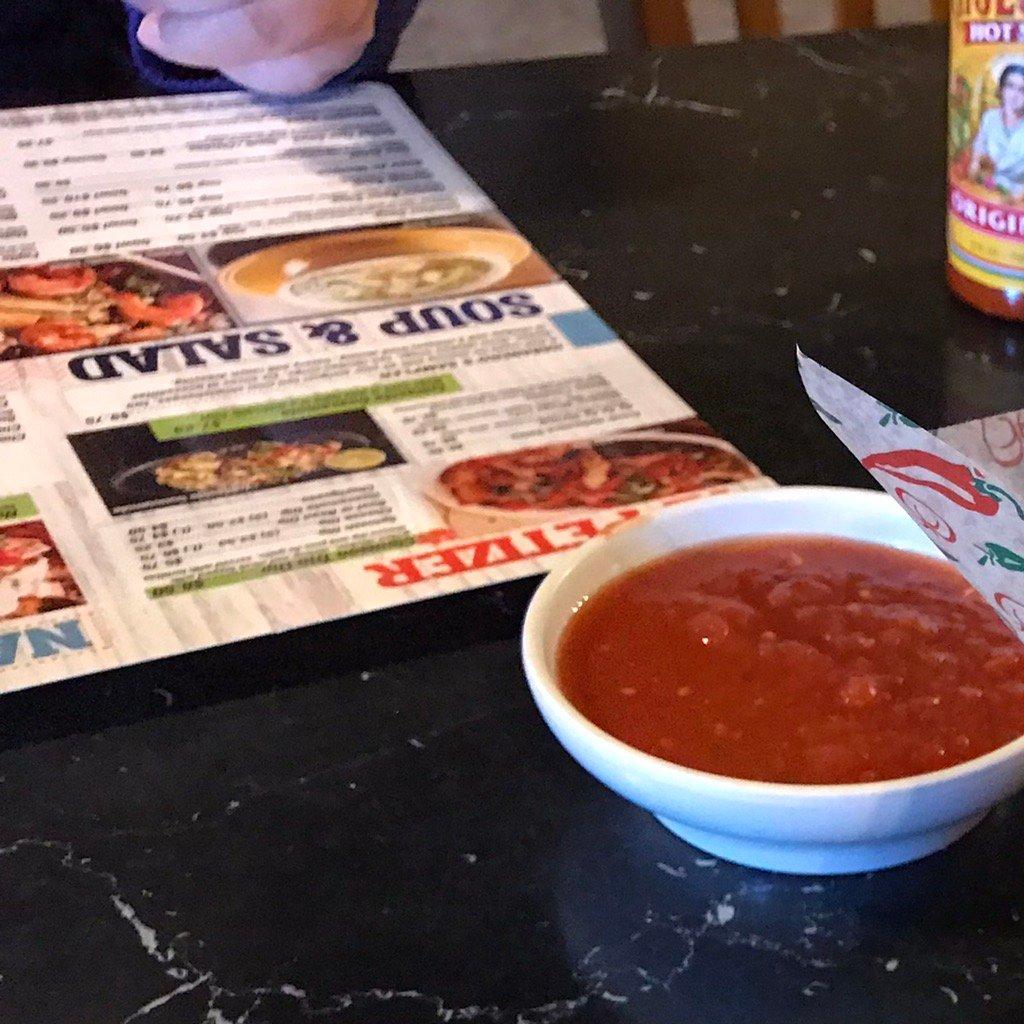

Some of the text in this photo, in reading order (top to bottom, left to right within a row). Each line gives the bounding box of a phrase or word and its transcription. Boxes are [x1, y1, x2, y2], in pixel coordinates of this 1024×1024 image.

[969, 21, 1012, 42] HOT
[67, 291, 544, 381] SOUP & SALAD
[364, 509, 640, 588] ETIZER
